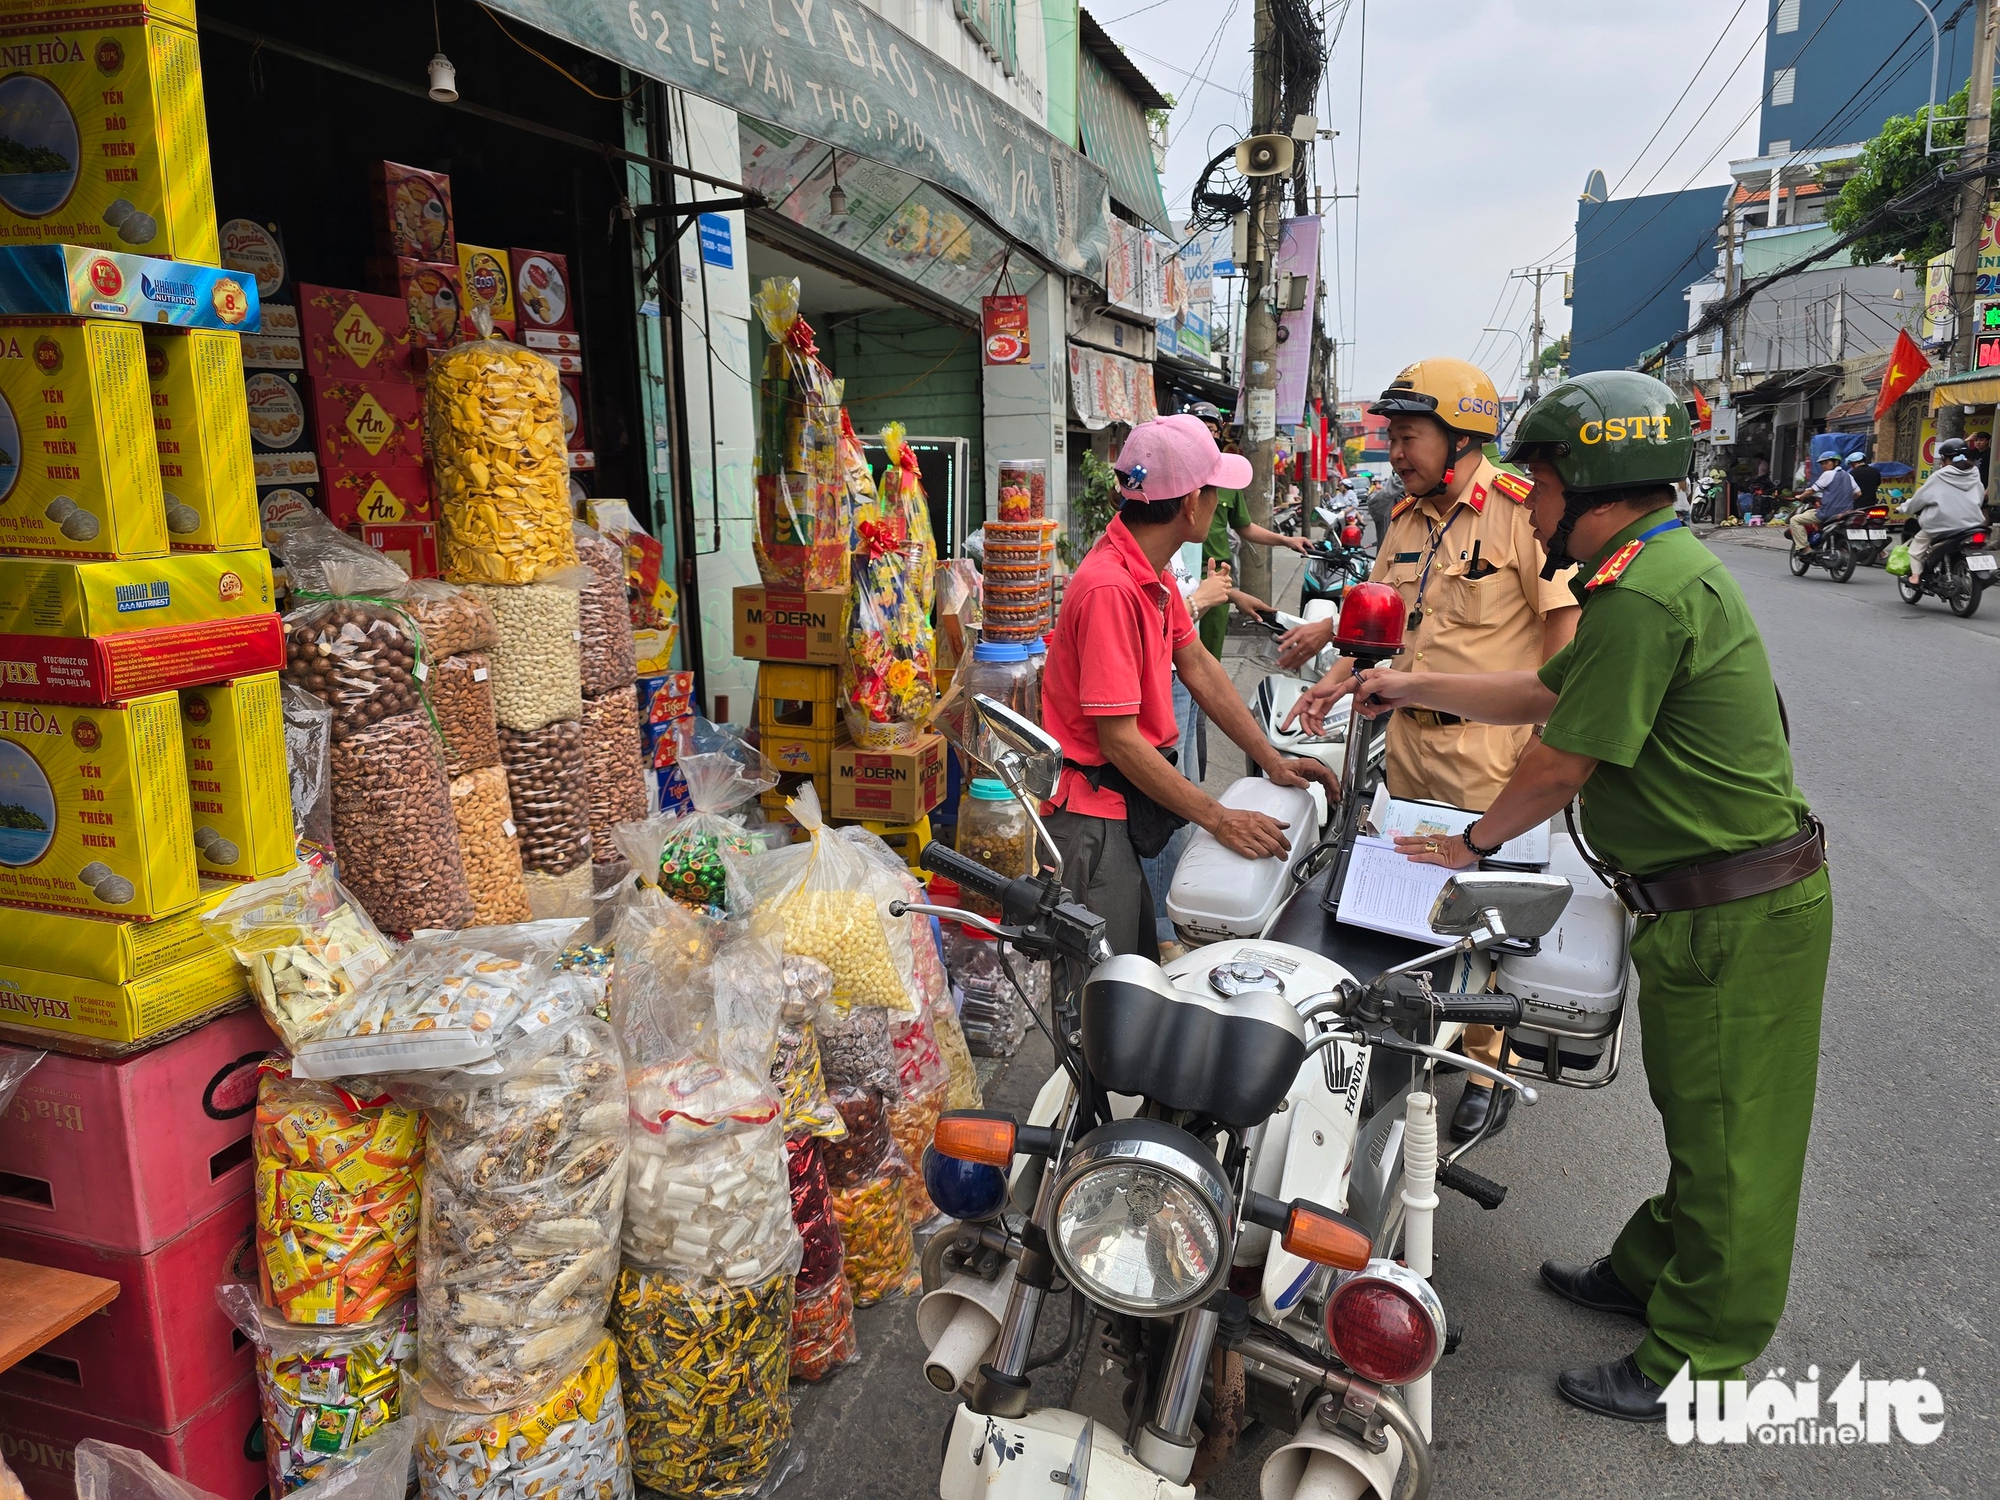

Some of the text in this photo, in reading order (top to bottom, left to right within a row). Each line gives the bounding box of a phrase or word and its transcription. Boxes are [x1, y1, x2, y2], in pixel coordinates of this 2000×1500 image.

[0, 36, 86, 68] NH HÒA
[628, 1, 672, 54] 62
[686, 22, 730, 75] LÊ
[739, 45, 797, 108] VĂN
[832, 6, 918, 98] BẢO
[102, 87, 124, 105] YẾN
[105, 113, 126, 131] ĐẢO
[102, 140, 136, 157] THIÊN
[105, 166, 138, 182] NHIÊN
[77, 221, 101, 235] Phèn
[154, 278, 195, 296] KHÁNH HÒA
[155, 294, 196, 305] NUTRITION
[225, 294, 235, 310] 8
[343, 318, 375, 346] An
[39, 350, 57, 360] 39%
[1052, 360, 1064, 405] 60
[42, 385, 64, 403] YẾN
[249, 384, 288, 406] Danisa
[46, 411, 67, 429] ĐẢO
[356, 408, 386, 434] An
[1579, 416, 1671, 445] CSTT
[43, 438, 77, 455] THIÊN
[158, 439, 180, 454] HIÊN
[47, 464, 80, 480] NHIÊN
[160, 462, 183, 477] HIÊN
[266, 501, 304, 522] Danisa
[367, 494, 397, 521] An
[20, 515, 44, 529] Phèn
[6, 536, 17, 544] ISO
[18, 535, 56, 546] 22000:2018
[371, 532, 384, 548] LU
[116, 579, 170, 602] KHÁNH HÒA
[136, 598, 170, 610] NUTRINEST
[747, 609, 825, 628] MODERN
[78, 658, 89, 666] ISO
[662, 699, 685, 716] Tiger
[14, 707, 62, 735] HÒA
[77, 728, 95, 739] 39%
[191, 734, 211, 750] YẾN
[79, 761, 101, 778] YẾN
[193, 756, 213, 772] ĐẢO
[840, 765, 907, 781] MODERN
[82, 785, 104, 802] ĐẢO
[190, 779, 221, 793] THIÊN
[193, 800, 223, 814] NHIÊN
[79, 810, 113, 825] THIÊN
[82, 833, 116, 848] NHIÊN
[19, 873, 51, 890] Đường
[52, 876, 76, 890] Phèn
[39, 891, 50, 900] ISO
[51, 893, 89, 905] 22000:2018
[1345, 1051, 1366, 1116] HONDA
[34, 1099, 85, 1132] Bia
